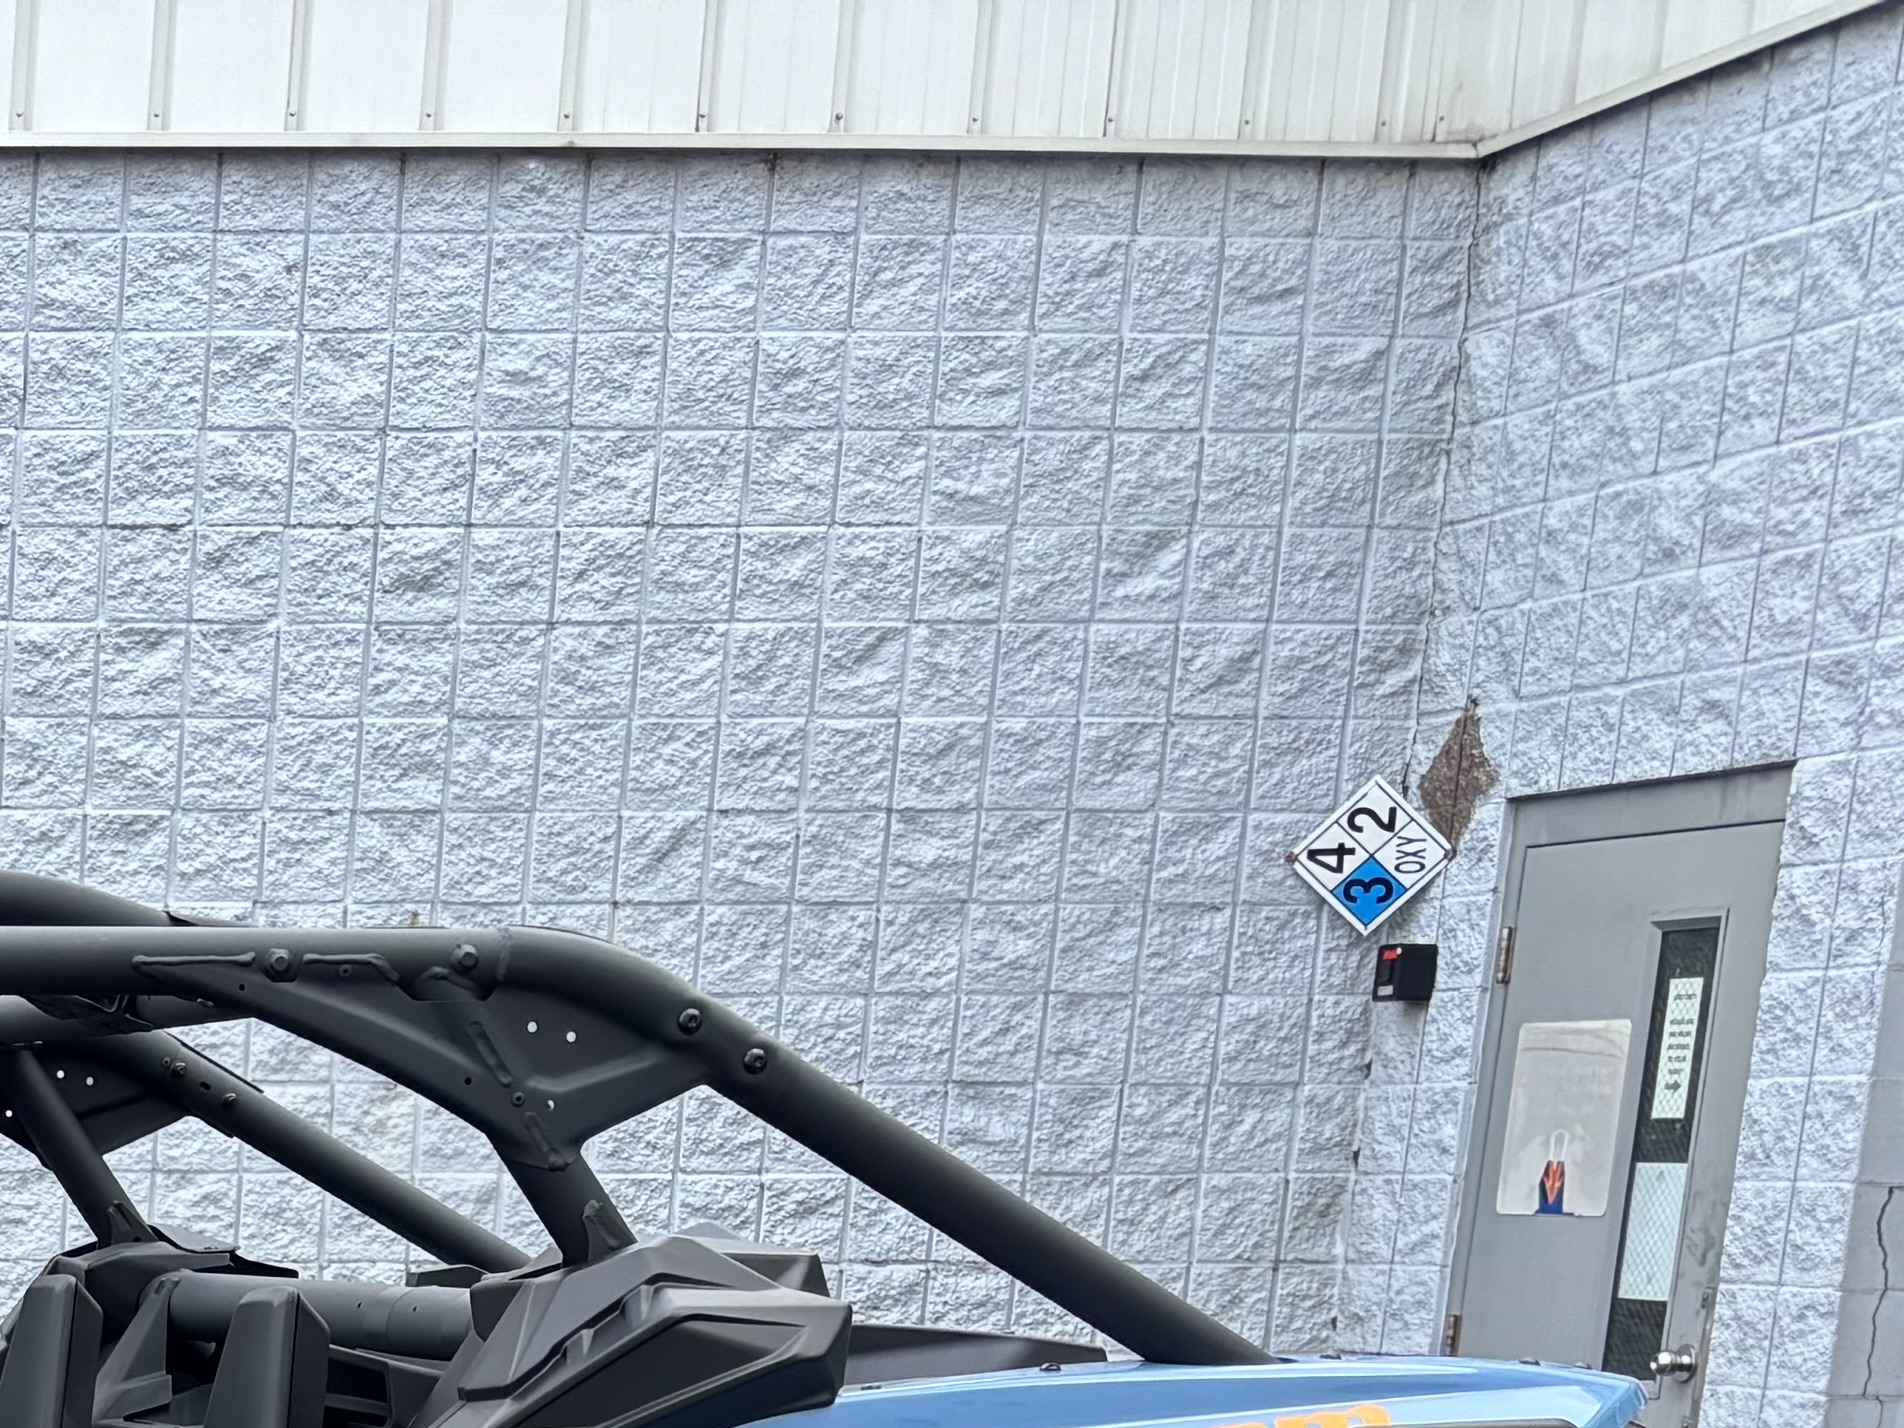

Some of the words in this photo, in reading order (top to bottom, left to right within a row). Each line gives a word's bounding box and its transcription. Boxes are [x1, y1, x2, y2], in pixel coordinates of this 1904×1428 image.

[1347, 807, 1397, 833] 2
[1307, 842, 1356, 874] 4
[1394, 836, 1427, 874] OXY
[1343, 877, 1394, 904] 3
